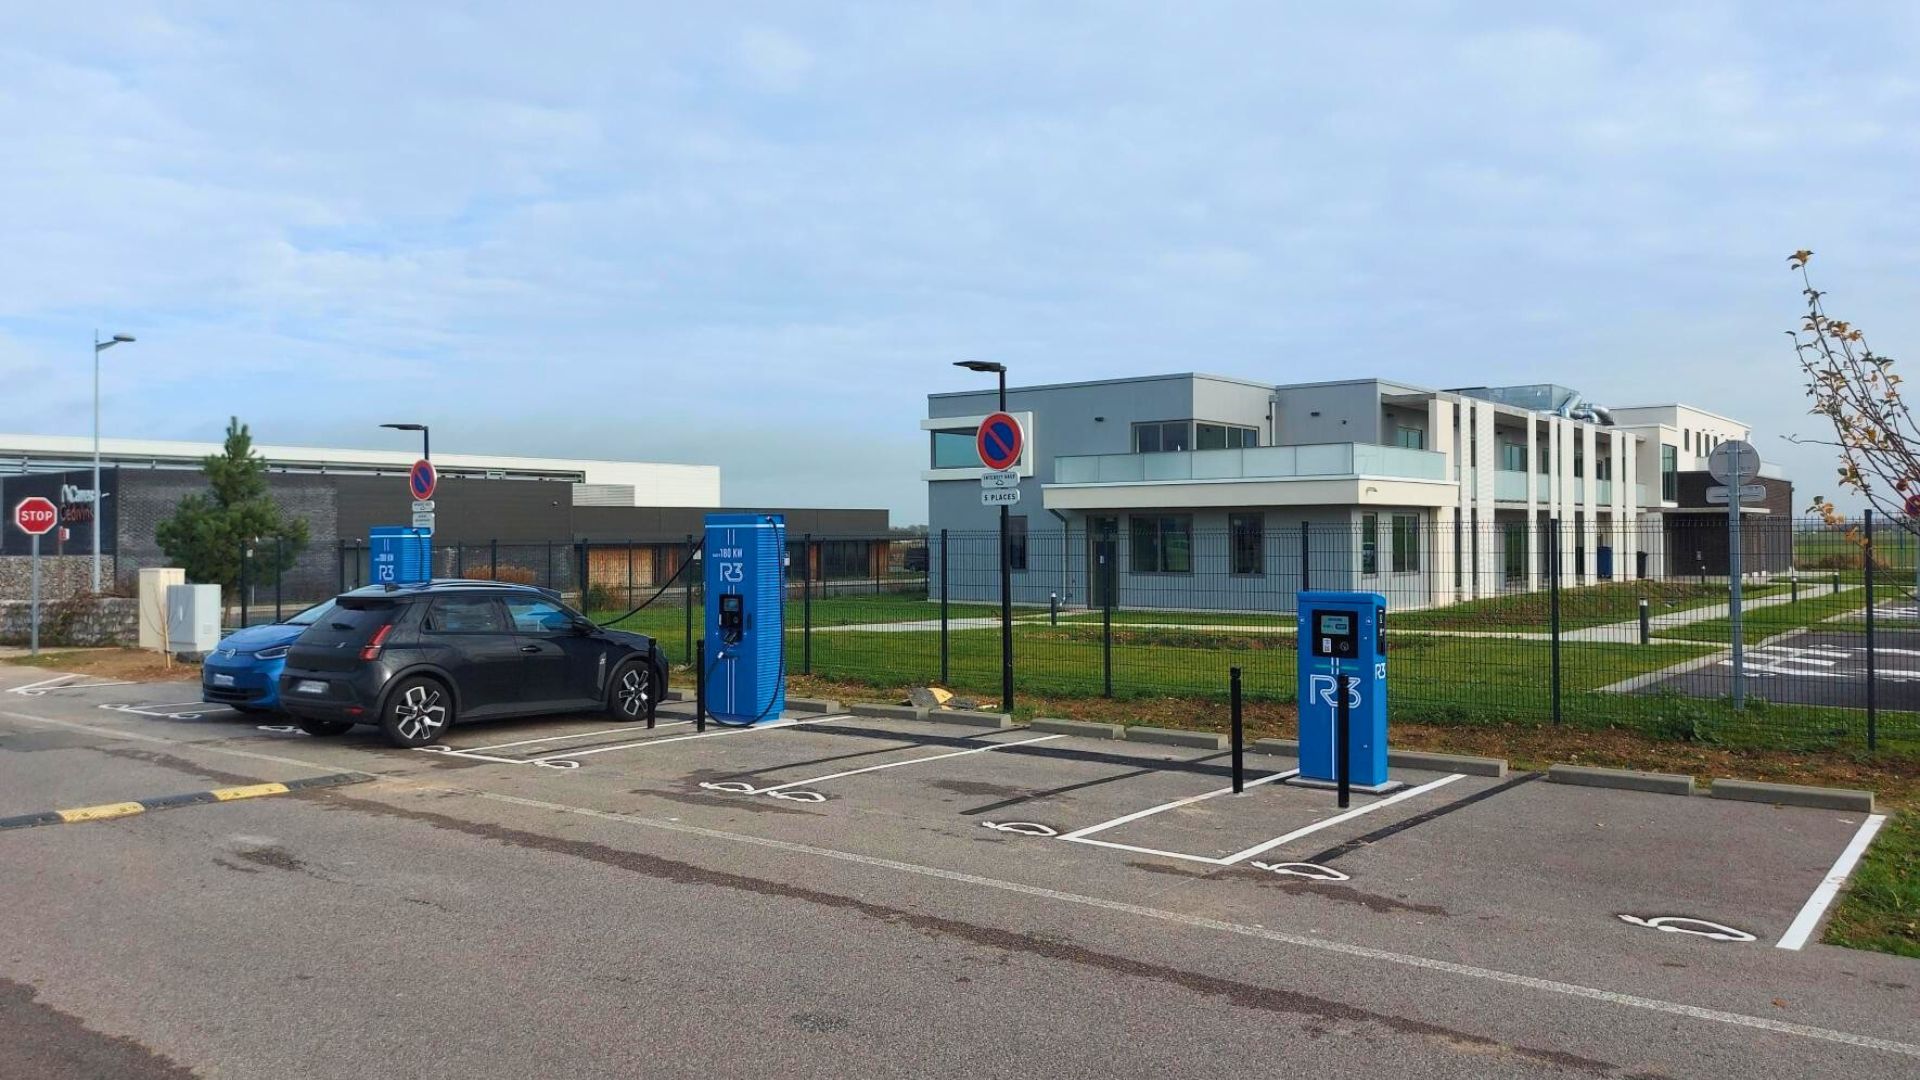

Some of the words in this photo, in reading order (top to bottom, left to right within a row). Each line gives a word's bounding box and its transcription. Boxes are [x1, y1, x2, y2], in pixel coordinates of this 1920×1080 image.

[21, 510, 53, 521] STOP
[379, 565, 394, 580] R3
[720, 562, 743, 582] R3
[1374, 662, 1386, 680] R3
[1310, 674, 1361, 708] R3
